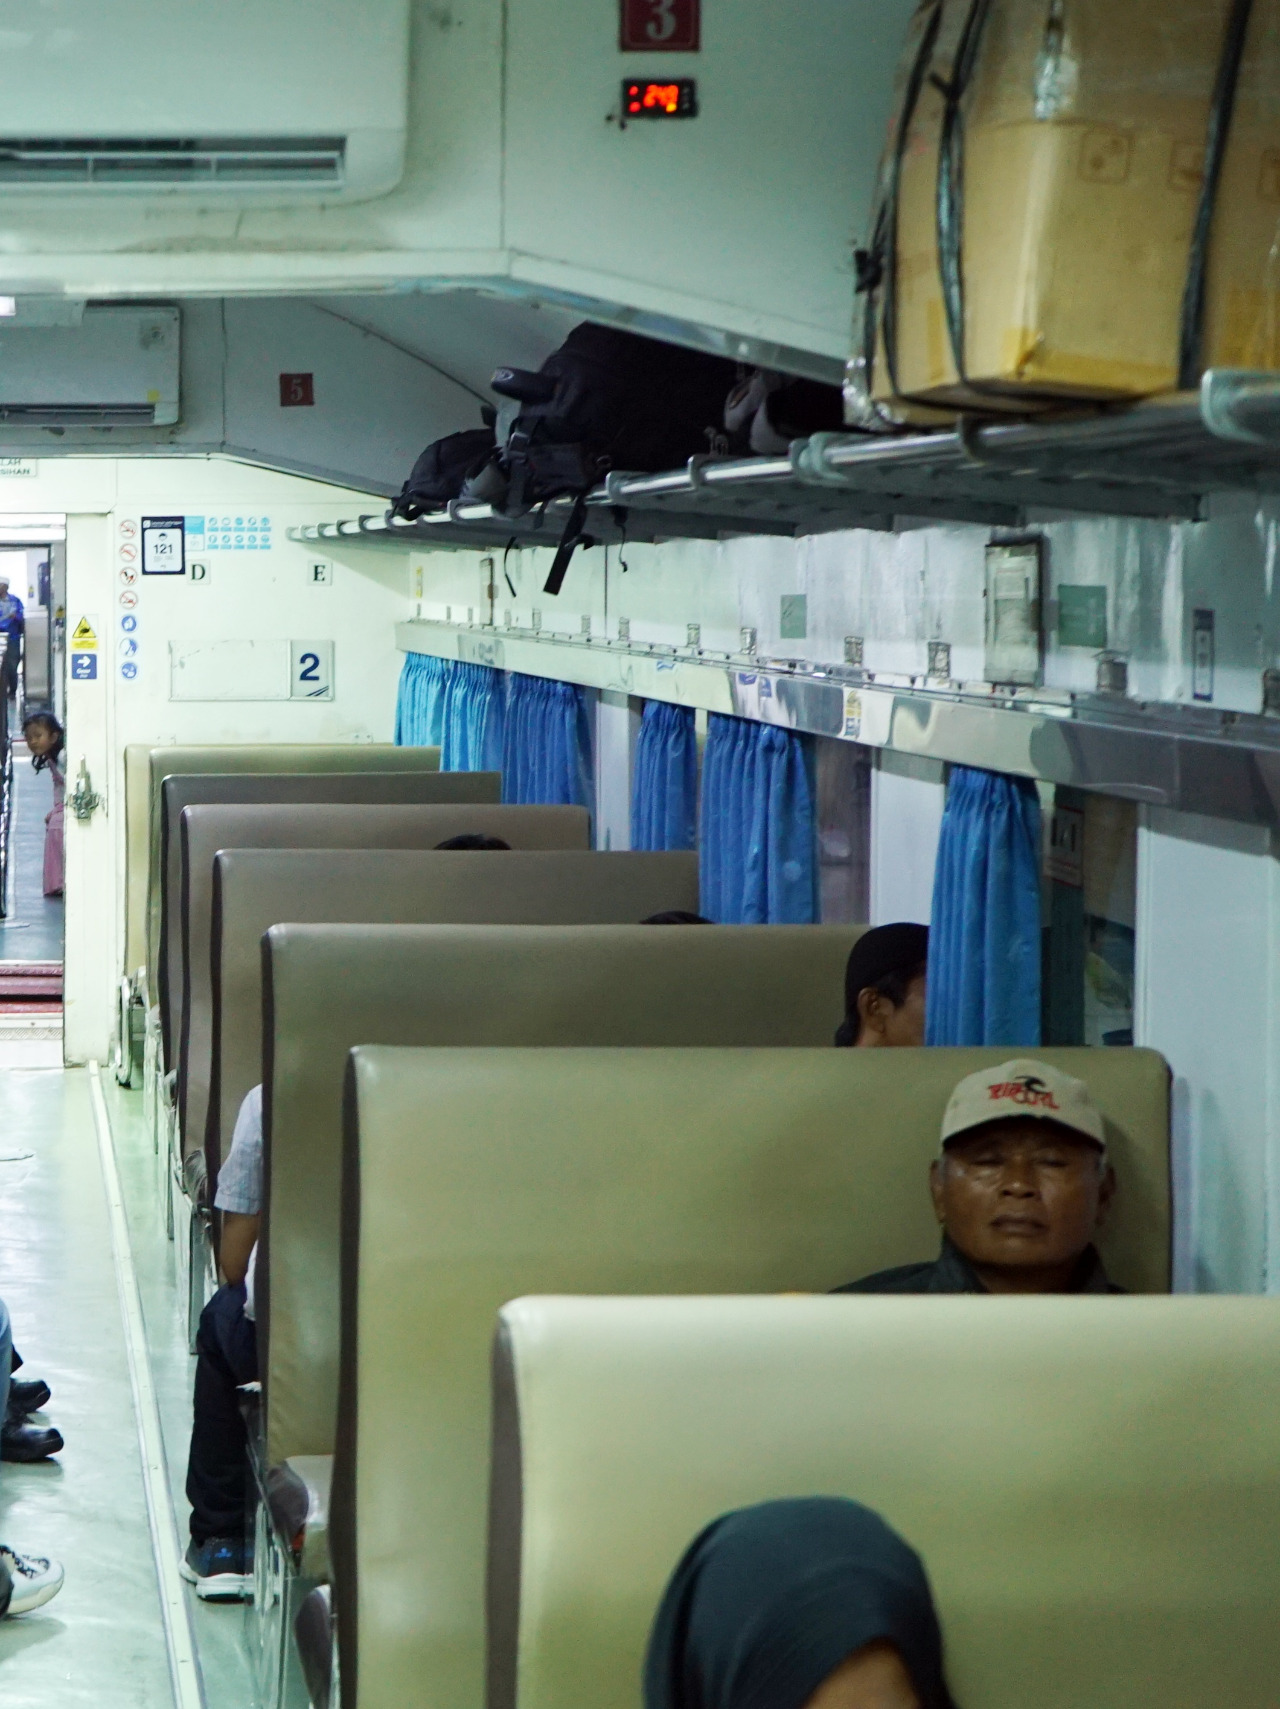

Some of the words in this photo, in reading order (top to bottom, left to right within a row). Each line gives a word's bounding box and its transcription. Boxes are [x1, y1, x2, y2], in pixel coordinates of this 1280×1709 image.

[646, 0, 678, 40] 3
[153, 544, 173, 555] 121
[191, 564, 206, 581] D
[313, 565, 326, 582] E
[299, 653, 320, 681] 2
